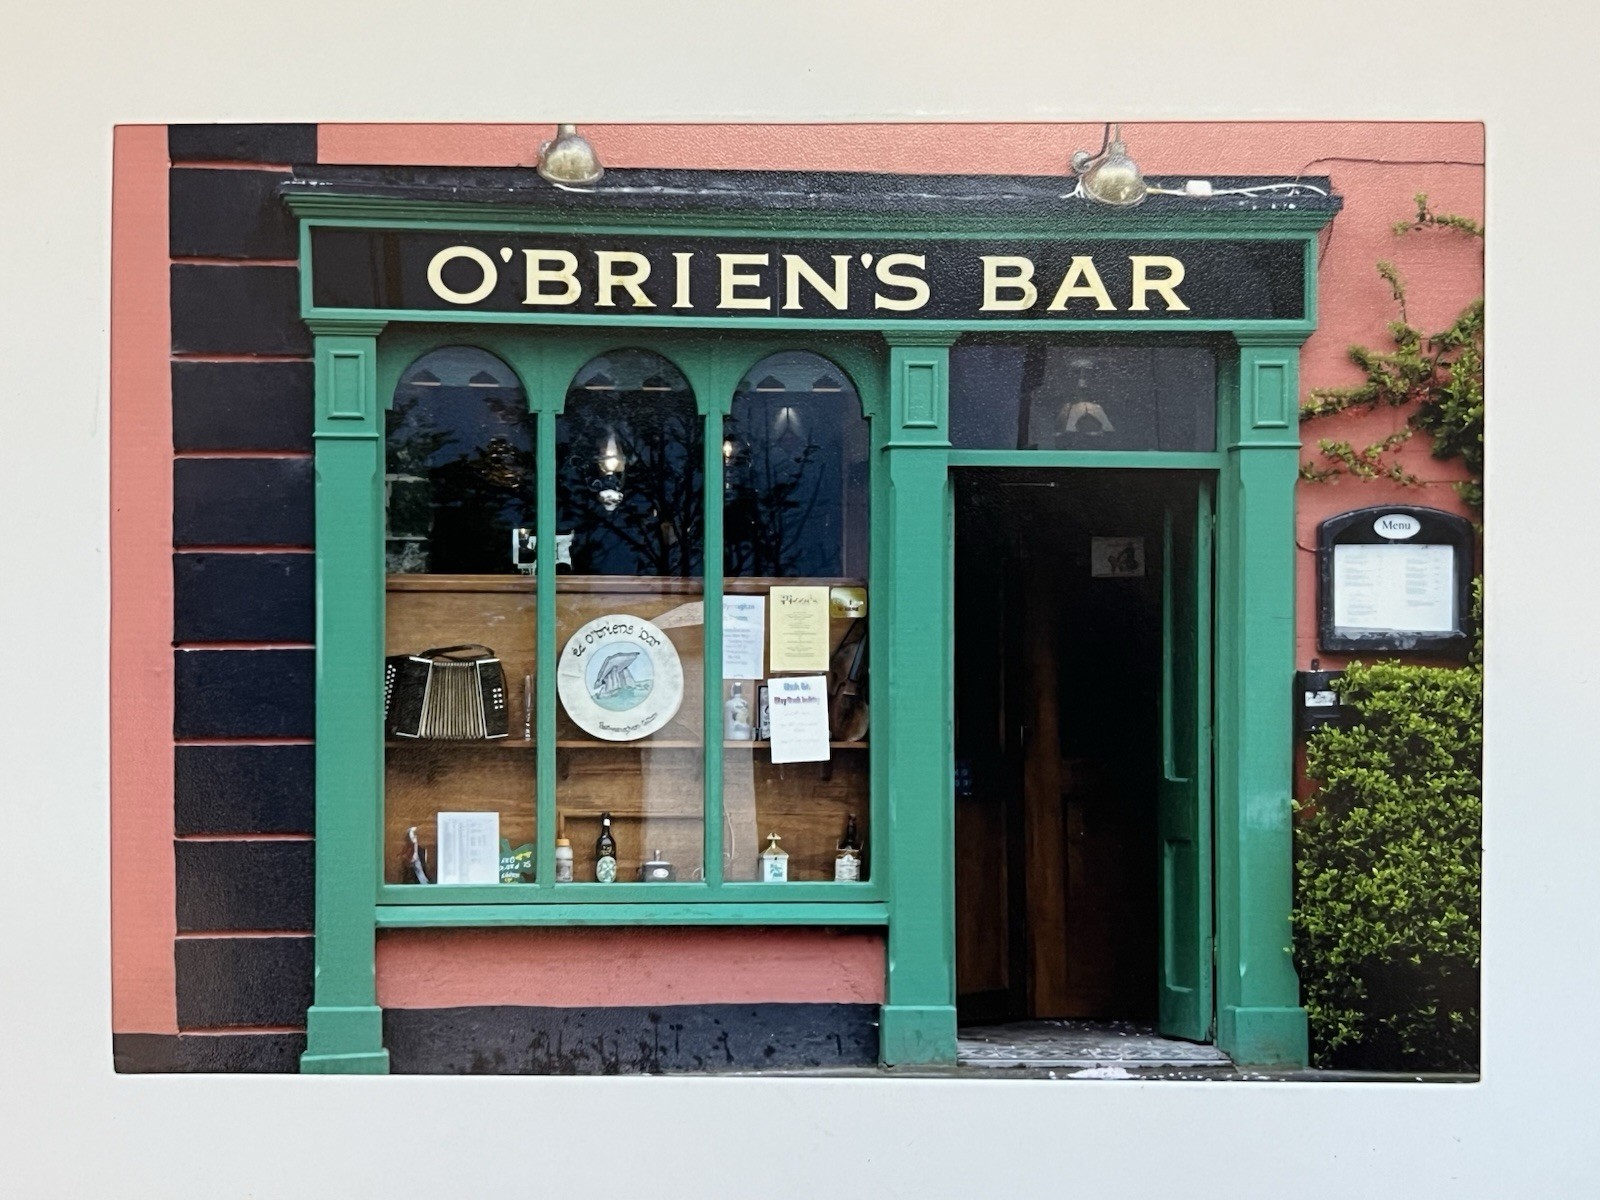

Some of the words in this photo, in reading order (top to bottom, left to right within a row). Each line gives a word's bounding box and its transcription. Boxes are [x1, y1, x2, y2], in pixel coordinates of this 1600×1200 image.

[425, 245, 932, 313] O'BRIEN'S
[980, 254, 1190, 313] BAR
[1382, 520, 1411, 530] Menu
